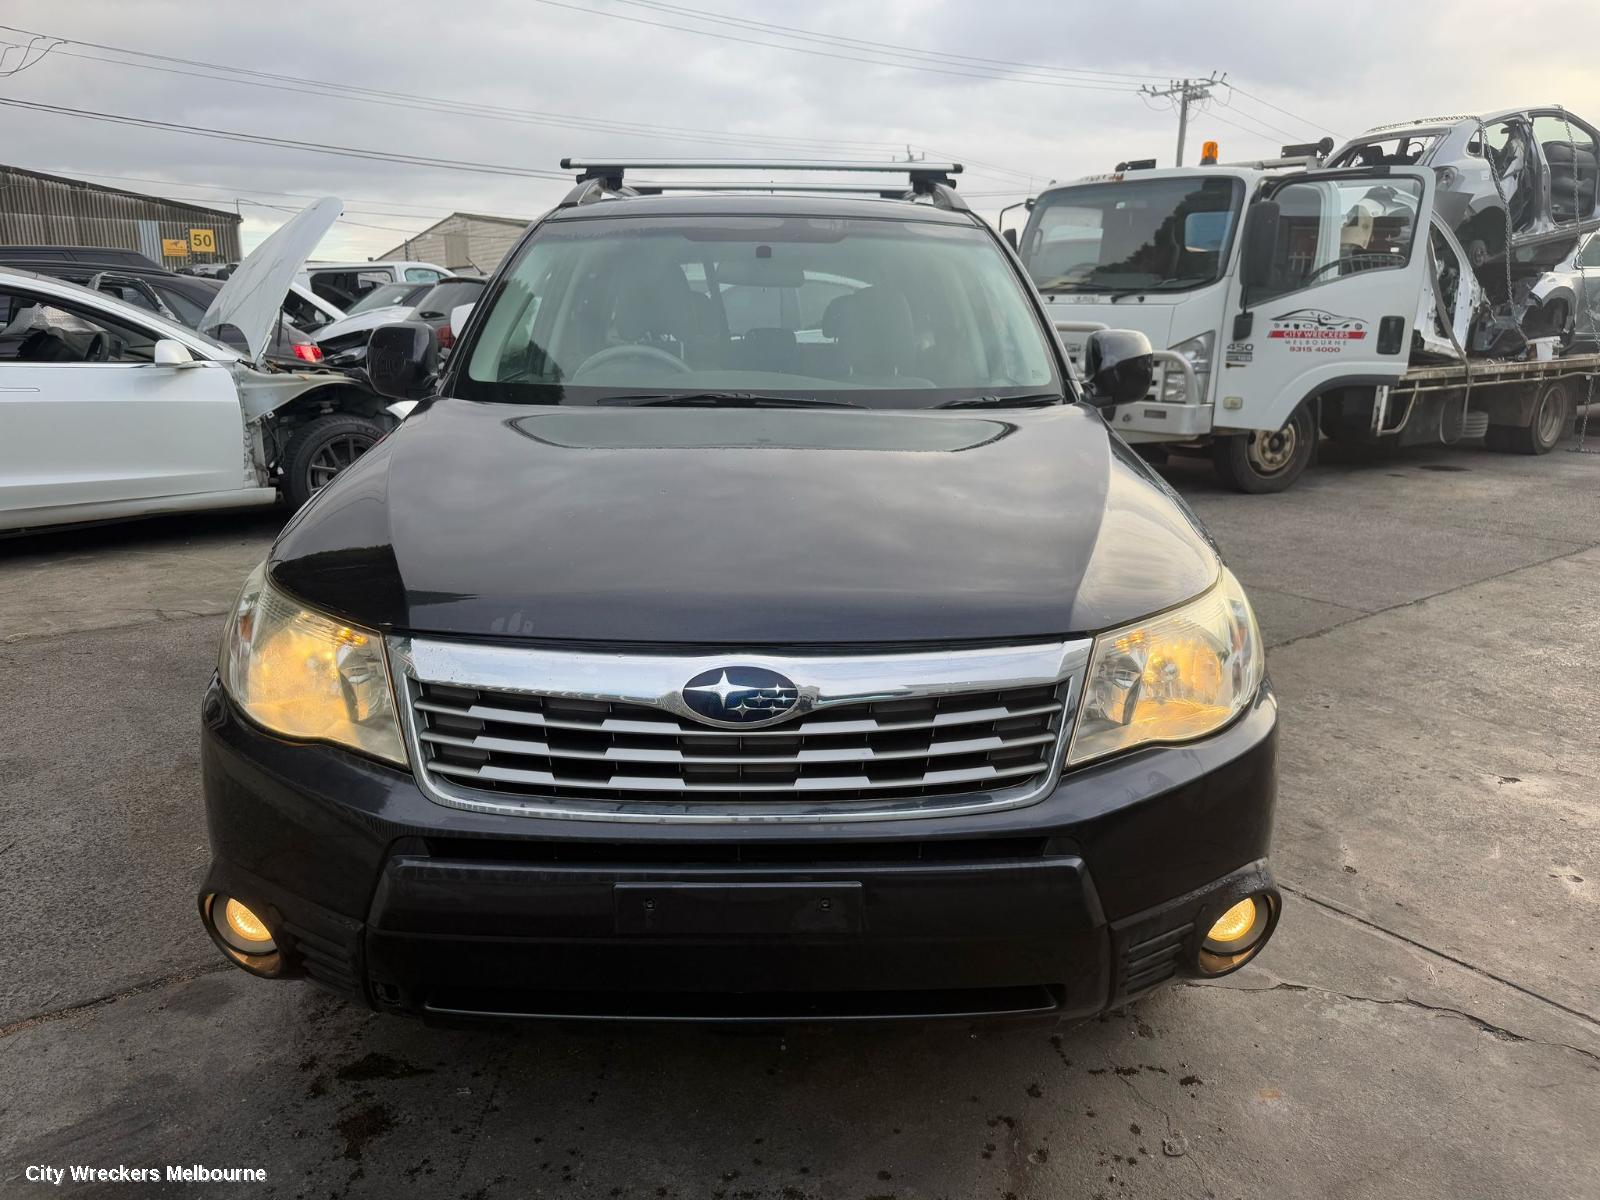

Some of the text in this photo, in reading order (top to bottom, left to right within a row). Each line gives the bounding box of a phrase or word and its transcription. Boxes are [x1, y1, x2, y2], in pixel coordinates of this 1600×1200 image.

[193, 234, 212, 247] 50
[1283, 330, 1350, 339] CITY WRECKERS
[1226, 343, 1254, 351] 450
